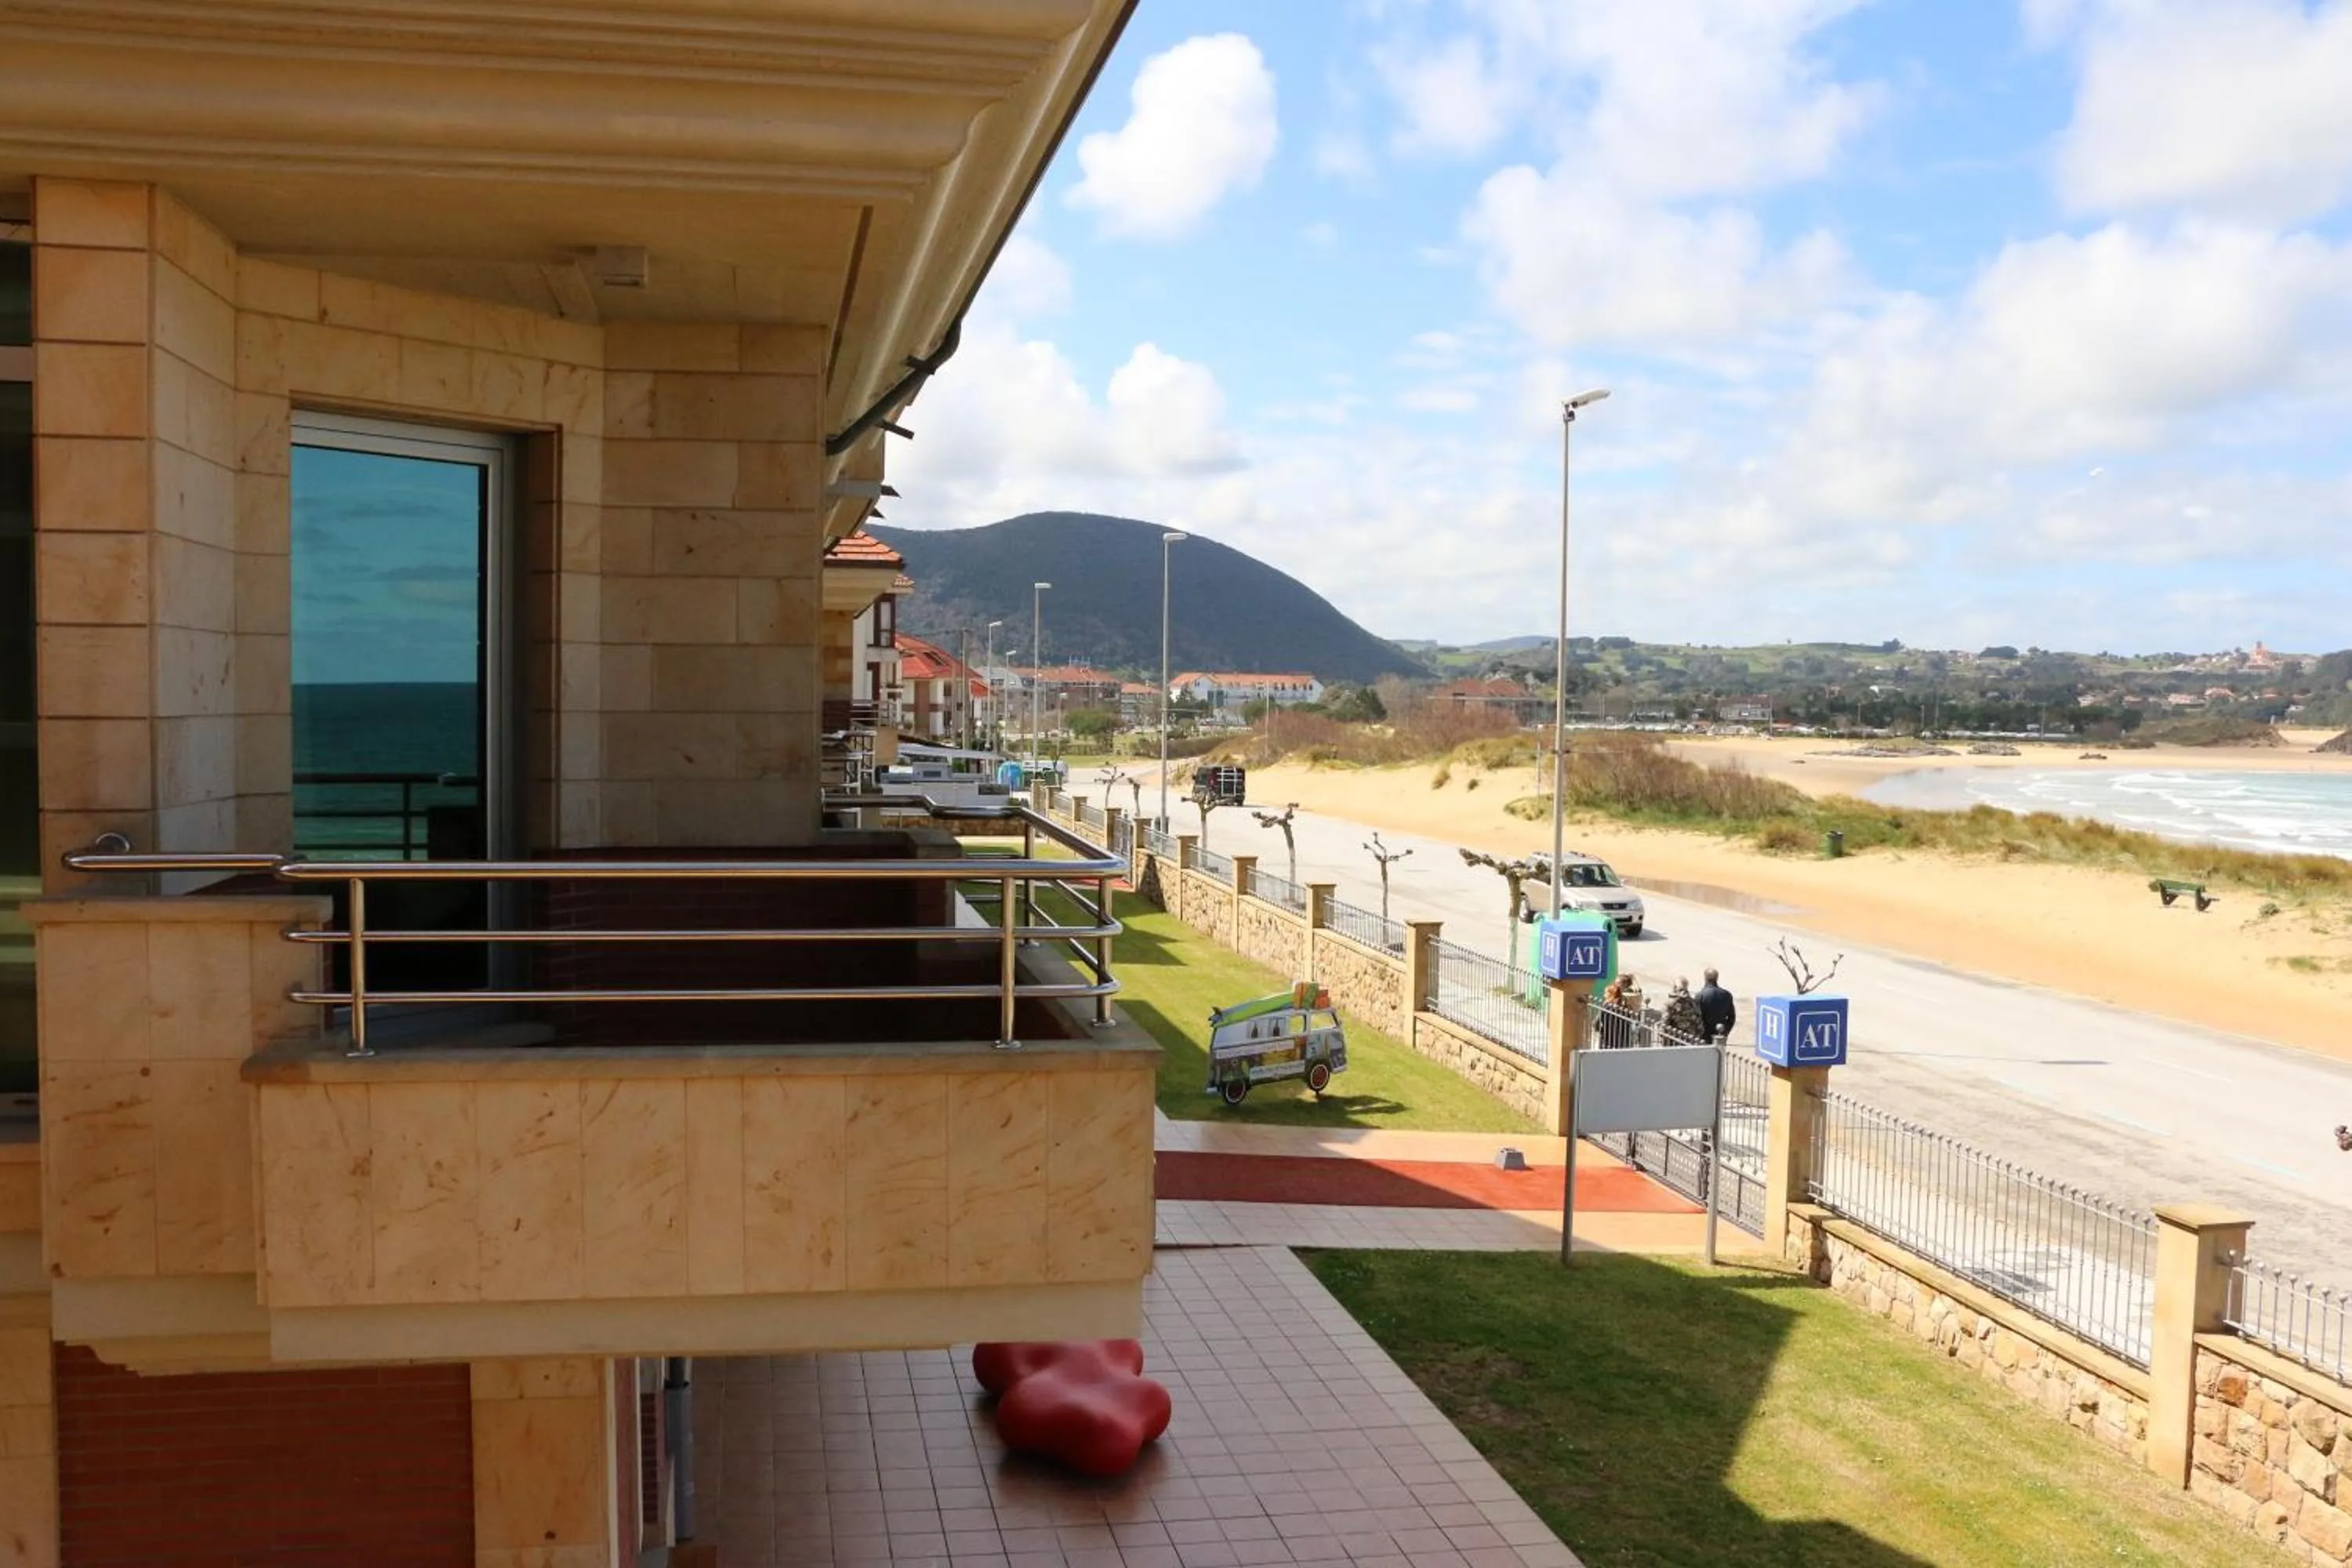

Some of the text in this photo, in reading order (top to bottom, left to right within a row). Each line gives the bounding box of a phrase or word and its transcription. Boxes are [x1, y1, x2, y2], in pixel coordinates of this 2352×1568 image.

[1570, 946, 1602, 965] AT
[1766, 1012, 1778, 1040] H
[1799, 1023, 1837, 1048] AT
